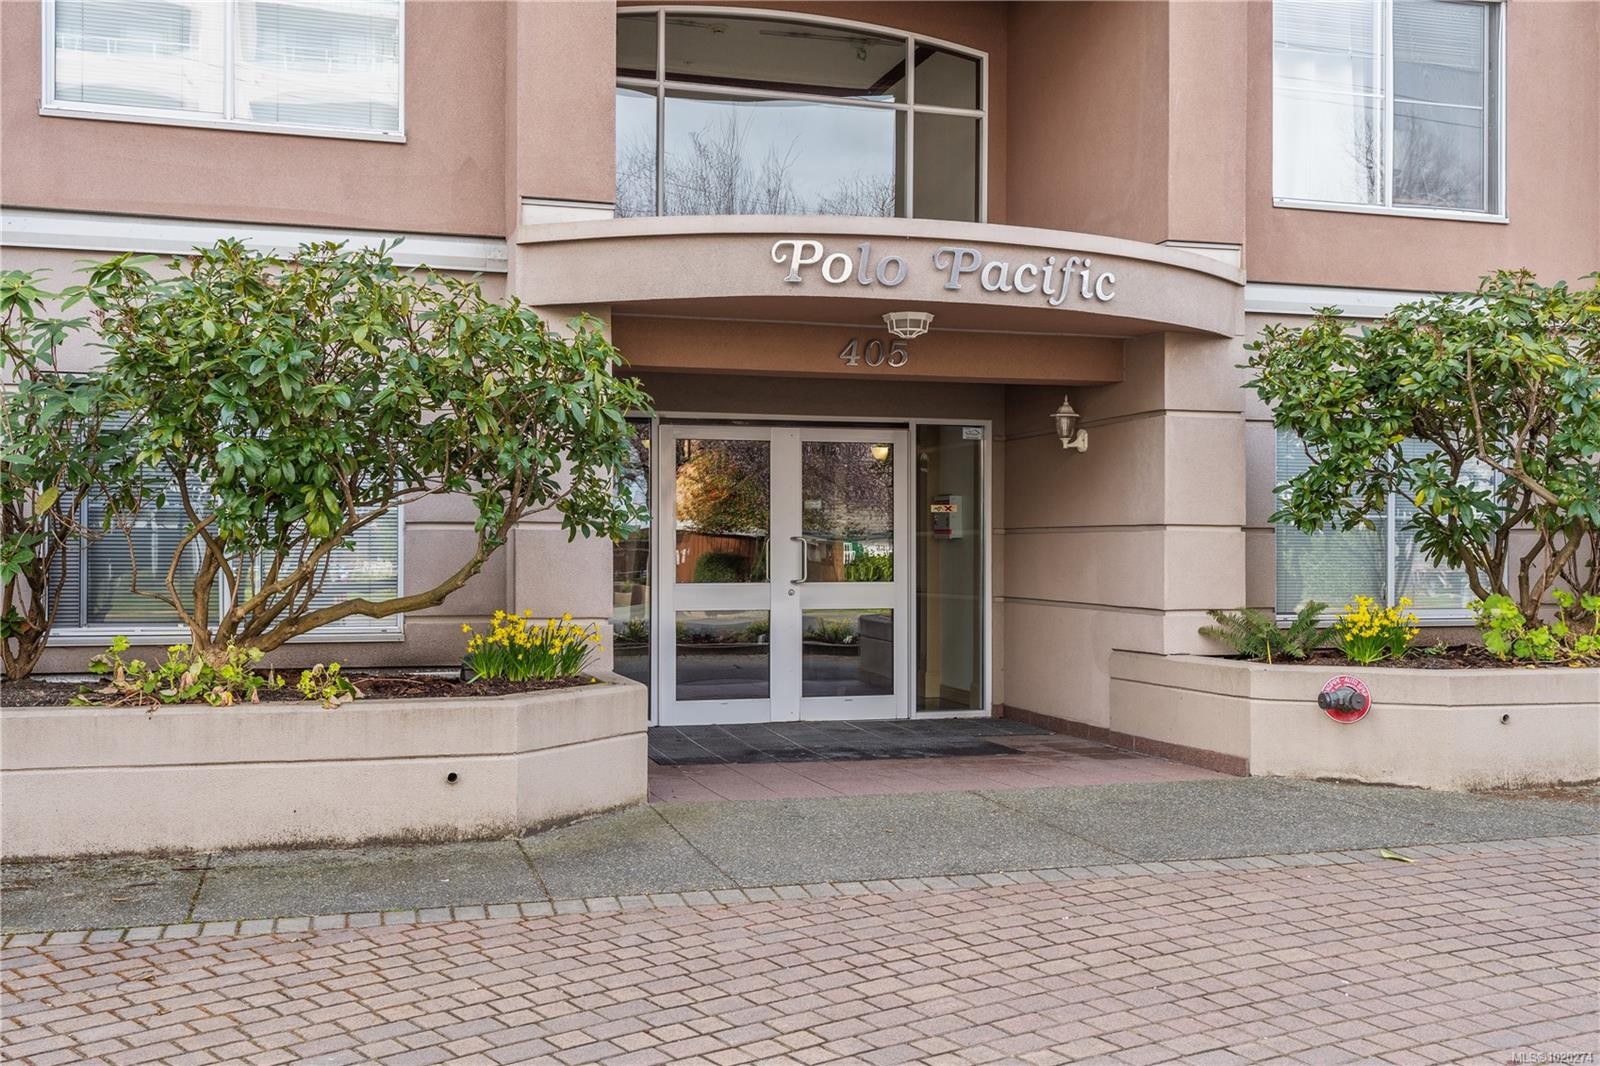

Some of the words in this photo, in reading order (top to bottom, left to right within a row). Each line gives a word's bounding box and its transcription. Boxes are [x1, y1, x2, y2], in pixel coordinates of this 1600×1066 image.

[770, 239, 909, 287] Polo
[932, 246, 1116, 306] Pacific
[838, 337, 910, 368] 405
